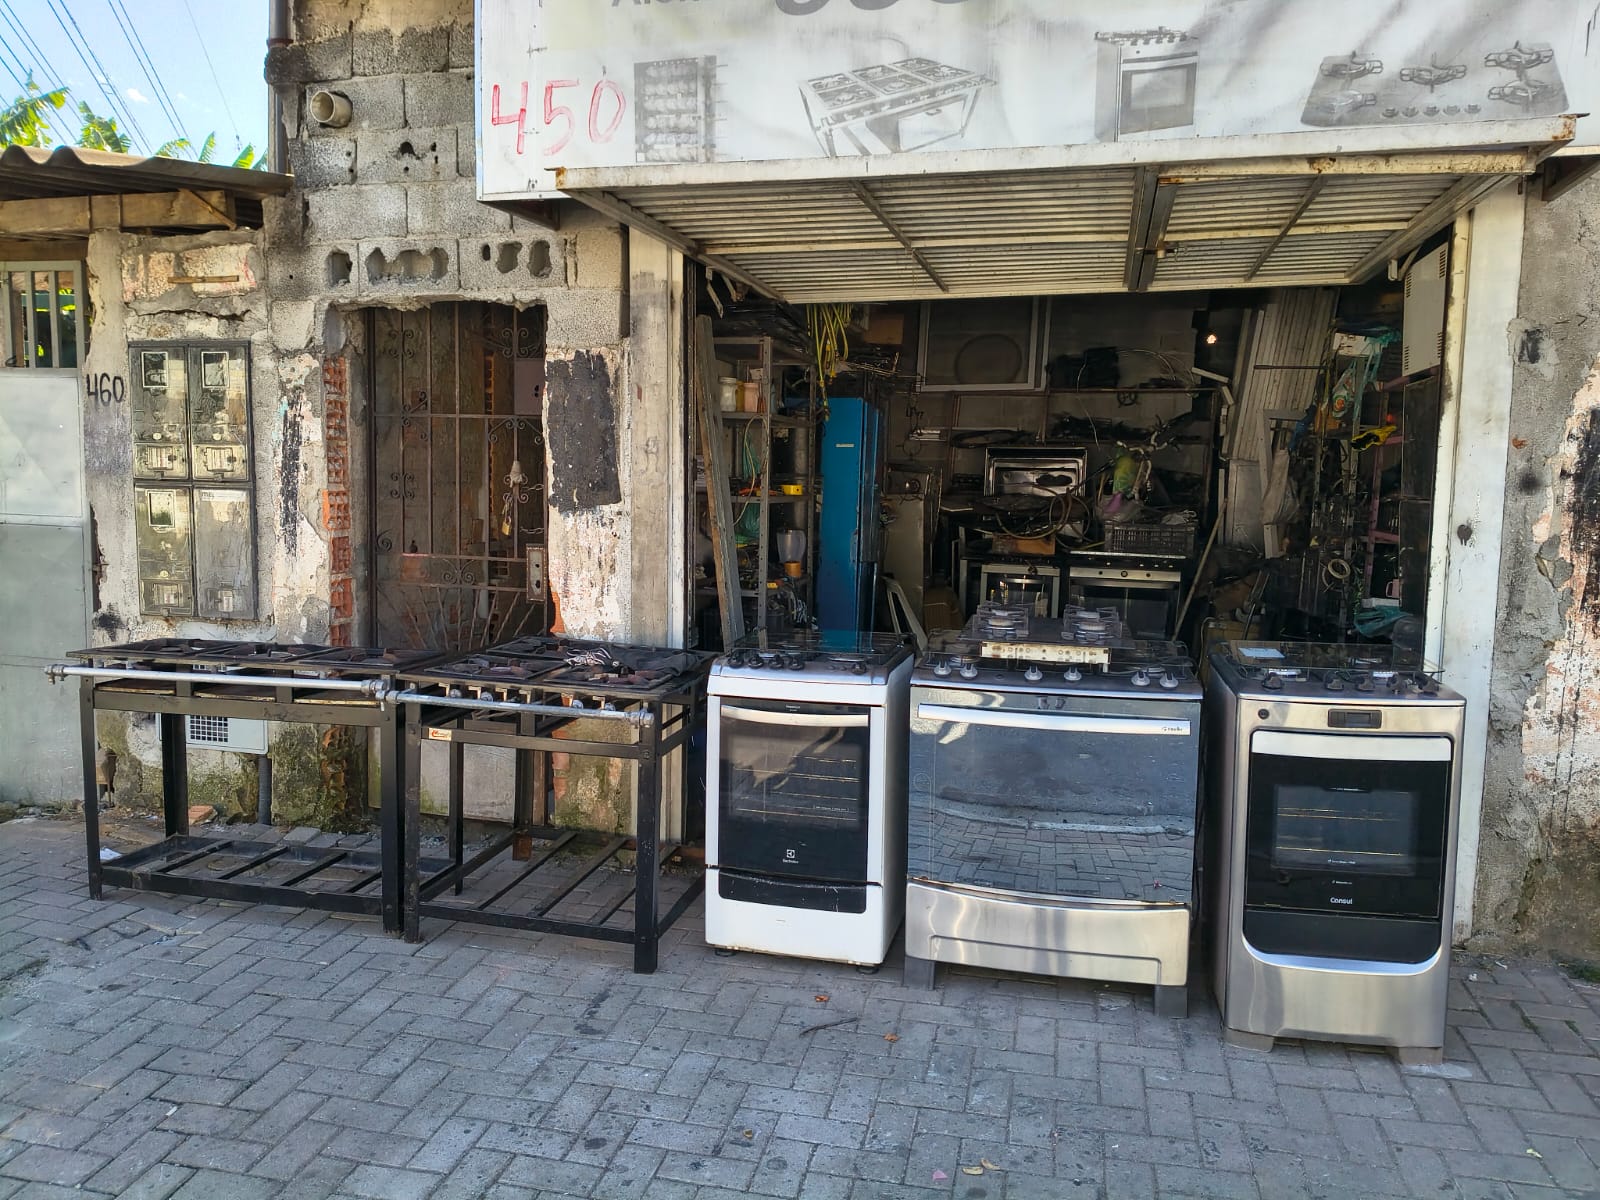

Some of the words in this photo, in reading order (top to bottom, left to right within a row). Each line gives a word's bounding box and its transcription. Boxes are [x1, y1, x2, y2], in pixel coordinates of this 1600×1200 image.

[491, 80, 627, 156] 450
[86, 372, 125, 409] 460
[1330, 897, 1353, 905] Consul
